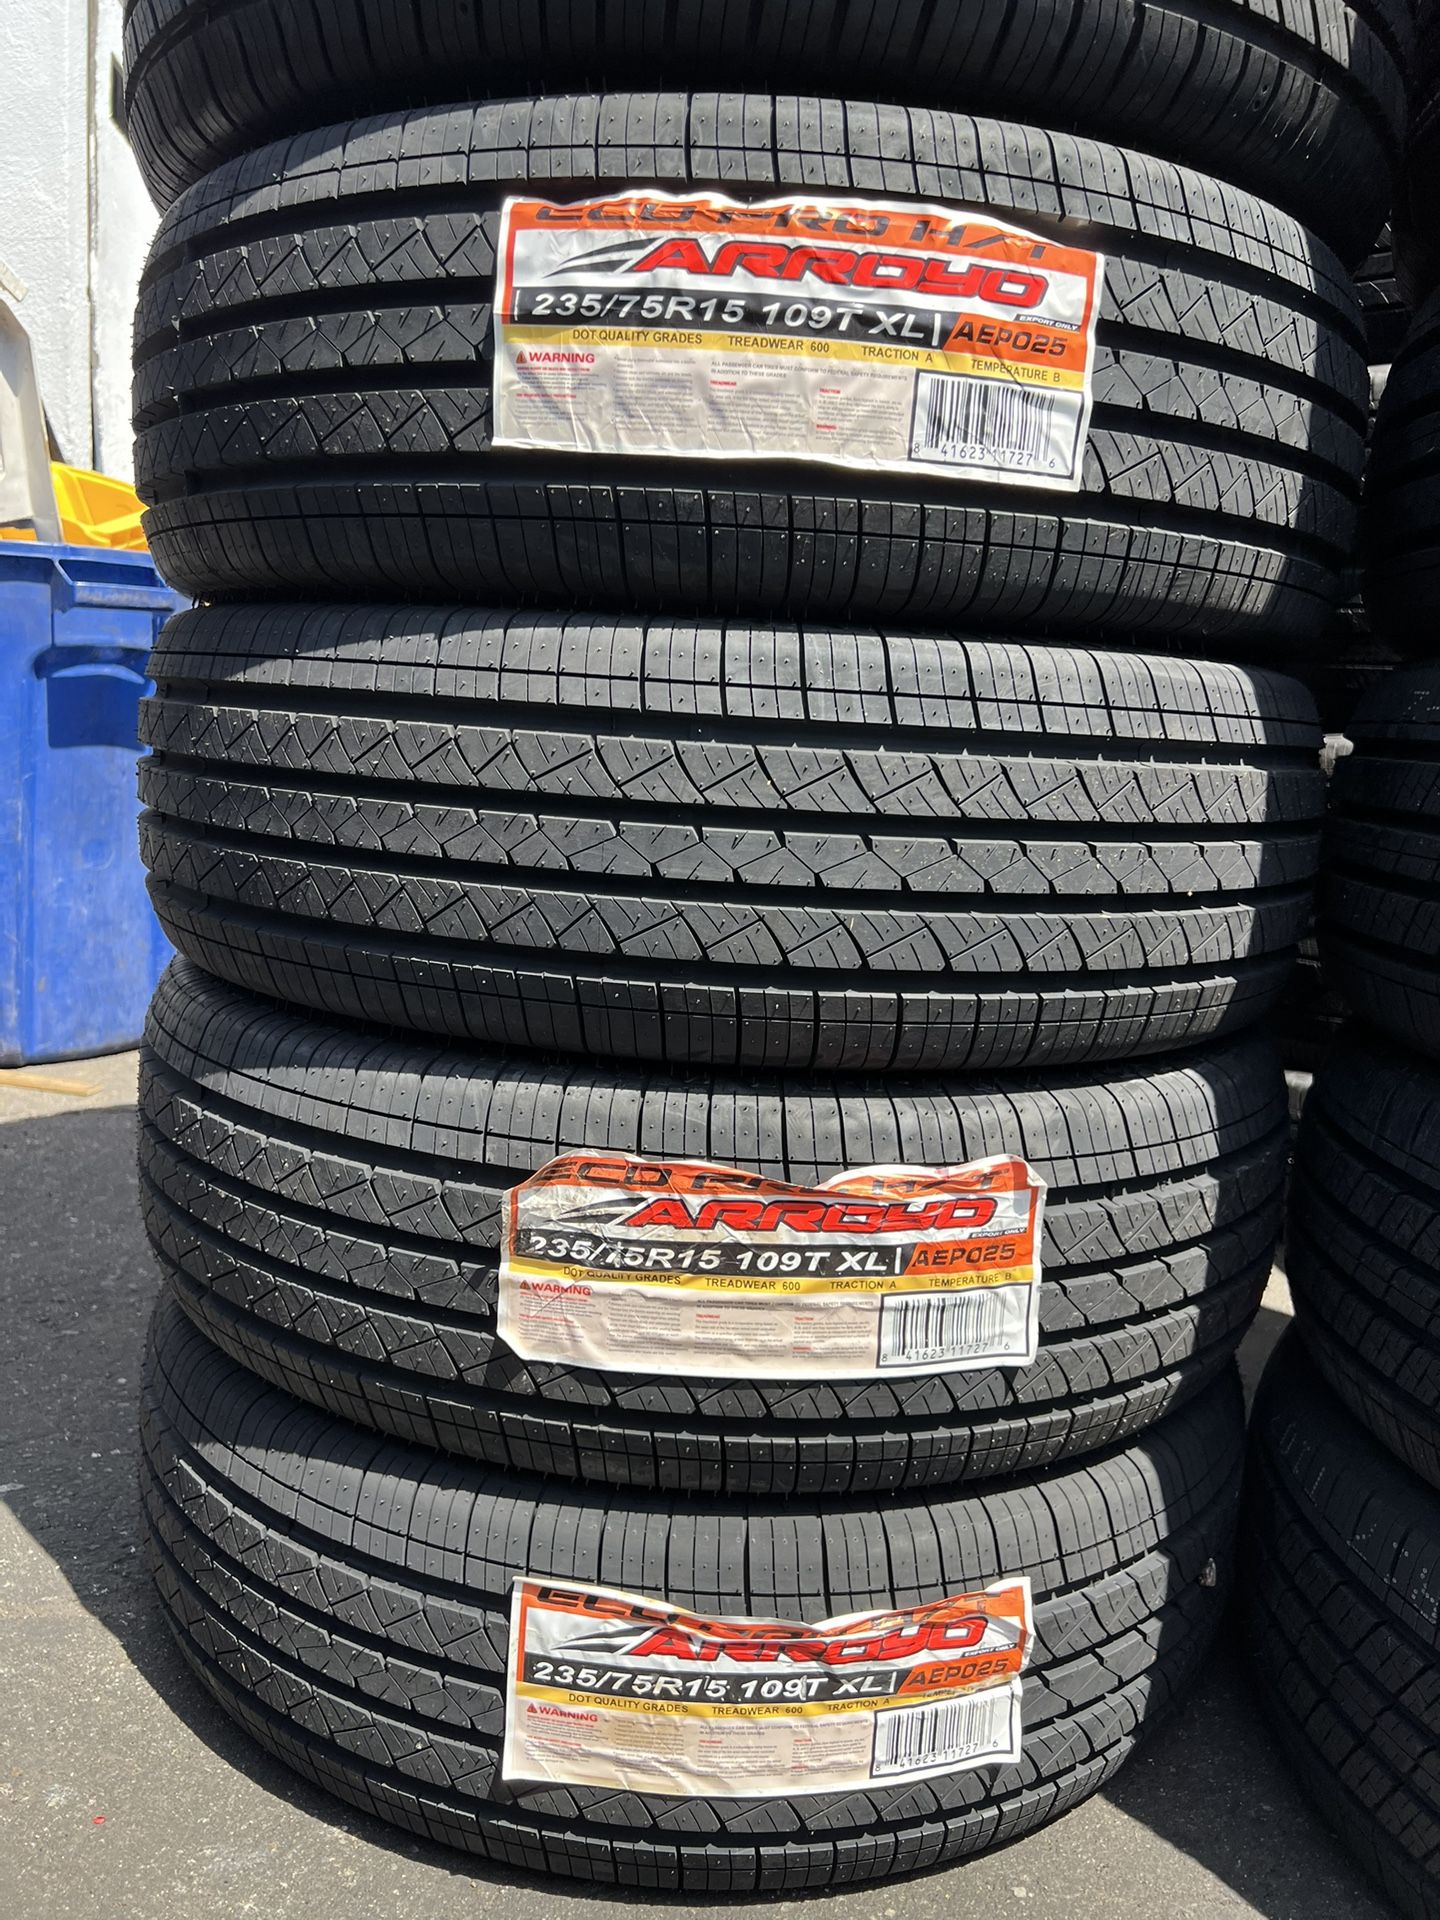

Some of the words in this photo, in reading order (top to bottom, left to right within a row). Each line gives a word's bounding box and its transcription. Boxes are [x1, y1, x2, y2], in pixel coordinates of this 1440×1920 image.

[630, 237, 1049, 309] ARROYO
[531, 292, 746, 323] 235/75R15
[761, 301, 864, 332] 109T
[868, 309, 926, 340] XL
[953, 320, 1069, 357] AEP025
[1018, 314, 1053, 327] EXPORT
[1054, 321, 1079, 331] ONLY
[529, 352, 596, 364] WARNING
[572, 329, 597, 341] DOT
[599, 330, 650, 344] QUALITY
[653, 331, 703, 345] GRADES
[728, 335, 804, 351] TREADWEAR
[810, 341, 830, 353] 600
[861, 345, 920, 362] TRACTION
[925, 352, 933, 363] A
[971, 359, 1048, 381] TEMPERATURE
[1053, 372, 1061, 383] B
[913, 443, 921, 453] 8
[941, 445, 986, 461] 41623
[1048, 457, 1055, 469] 6
[620, 1197, 998, 1234] ARROYO
[736, 1250, 832, 1272] 109T
[835, 1250, 888, 1272] XL
[911, 1243, 1017, 1268] AEP025
[532, 1282, 592, 1297] WARNING
[563, 1267, 584, 1278] DOT
[635, 1273, 682, 1285] GRADES
[705, 1277, 776, 1289] TREADWEAR
[782, 1280, 801, 1291] 600
[830, 1280, 884, 1289] TRACTION
[889, 1280, 897, 1289] A
[928, 1272, 1000, 1287] TEMPERATURE
[1004, 1272, 1012, 1281] B
[881, 1353, 888, 1362] 8
[905, 1347, 945, 1361] 41623
[950, 1342, 989, 1356] 11727
[1004, 1341, 1010, 1350] 6
[627, 1616, 990, 1665] ARROYO
[533, 1661, 727, 1699] 235/75R15
[741, 1676, 829, 1698] 109T
[833, 1676, 883, 1695] XL
[908, 1658, 1009, 1686] AEP025
[539, 1706, 598, 1723] WARNING
[569, 1693, 591, 1703] DOT
[594, 1696, 640, 1710] QUALITY
[643, 1702, 689, 1714] GRADES
[712, 1706, 779, 1715] TREADWEAR
[785, 1705, 803, 1714] 600
[828, 1699, 878, 1711] TRACTION
[883, 1698, 890, 1706] A
[900, 1752, 937, 1768] 41623
[943, 1743, 979, 1760] 11727
[992, 1739, 999, 1748] 6
